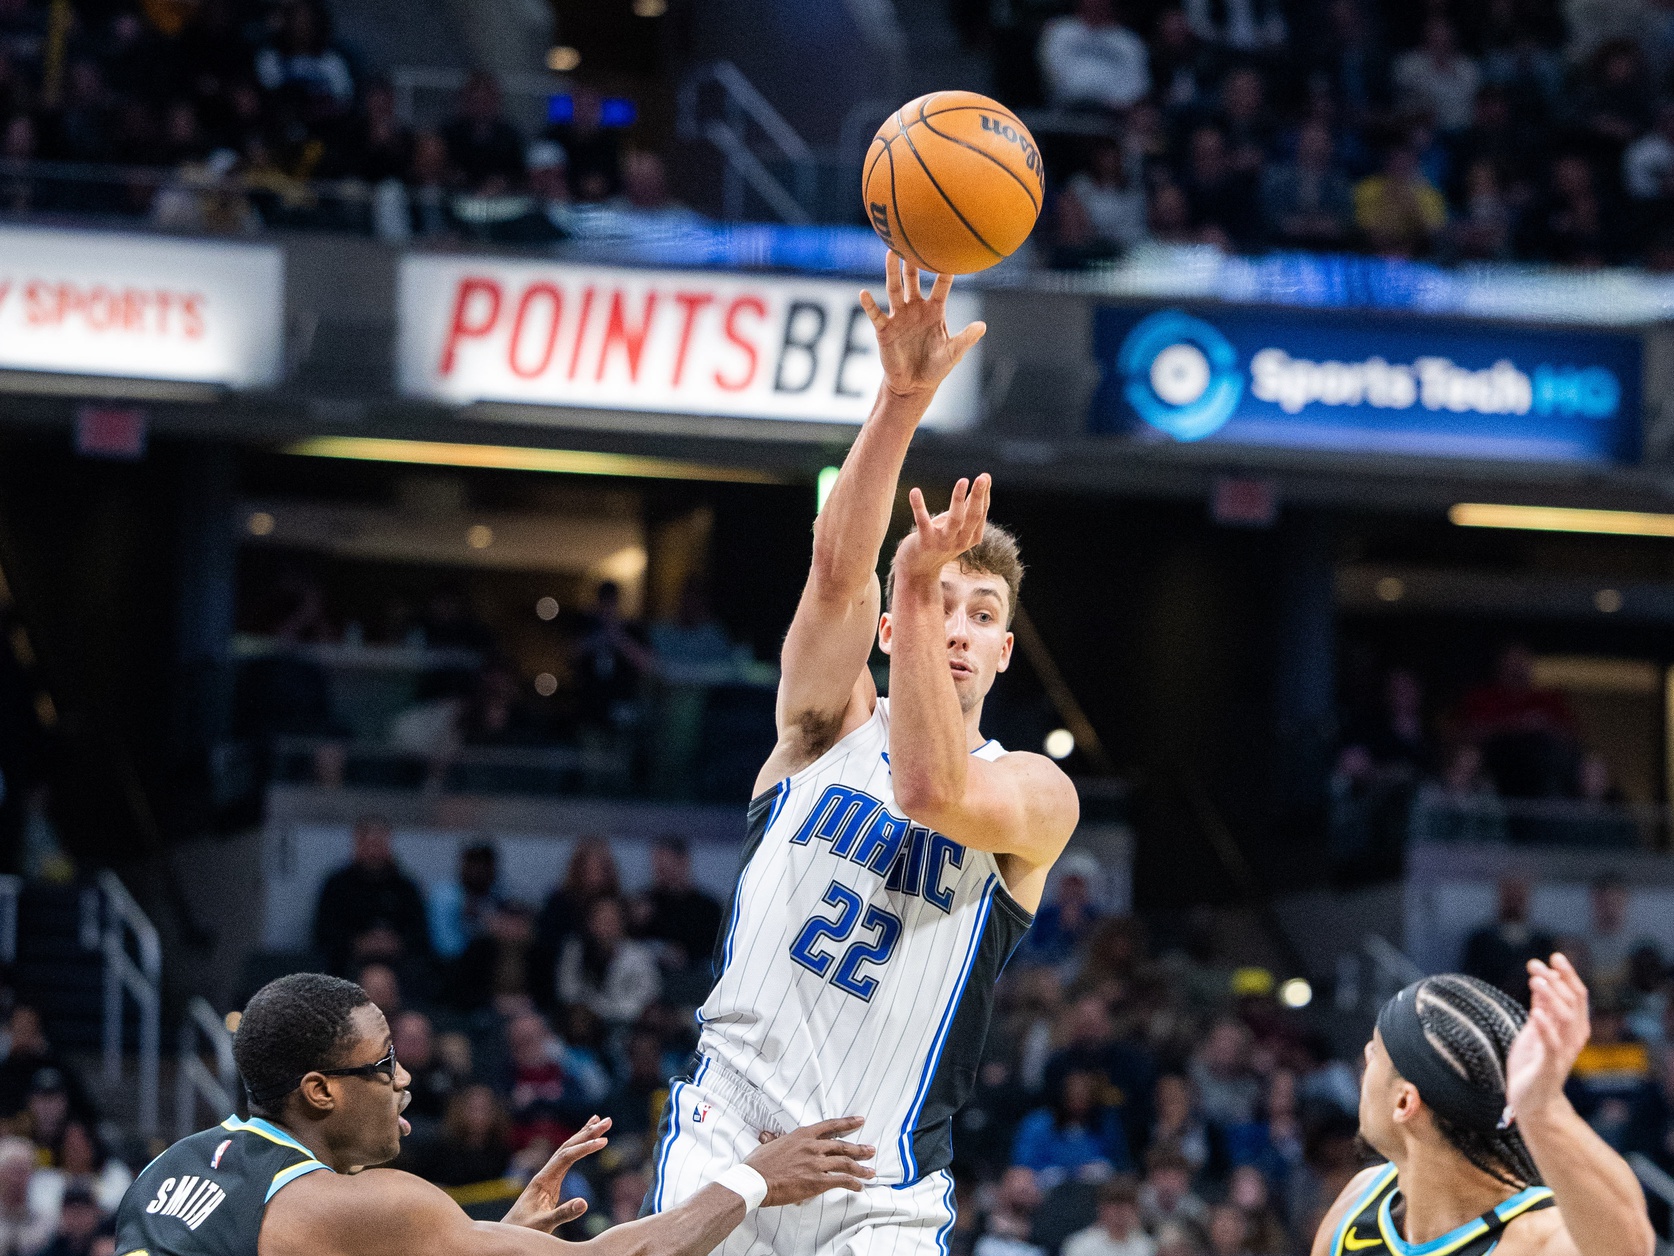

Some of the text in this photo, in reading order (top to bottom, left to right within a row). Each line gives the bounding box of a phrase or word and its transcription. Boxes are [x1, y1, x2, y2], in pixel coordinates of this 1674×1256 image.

[23, 279, 206, 341] SPORTS
[439, 276, 888, 400] POINTSBE
[1251, 349, 1416, 413] Sports
[1416, 357, 1532, 415] Tech
[789, 880, 902, 1003] 22
[146, 1175, 226, 1231] SMITH
